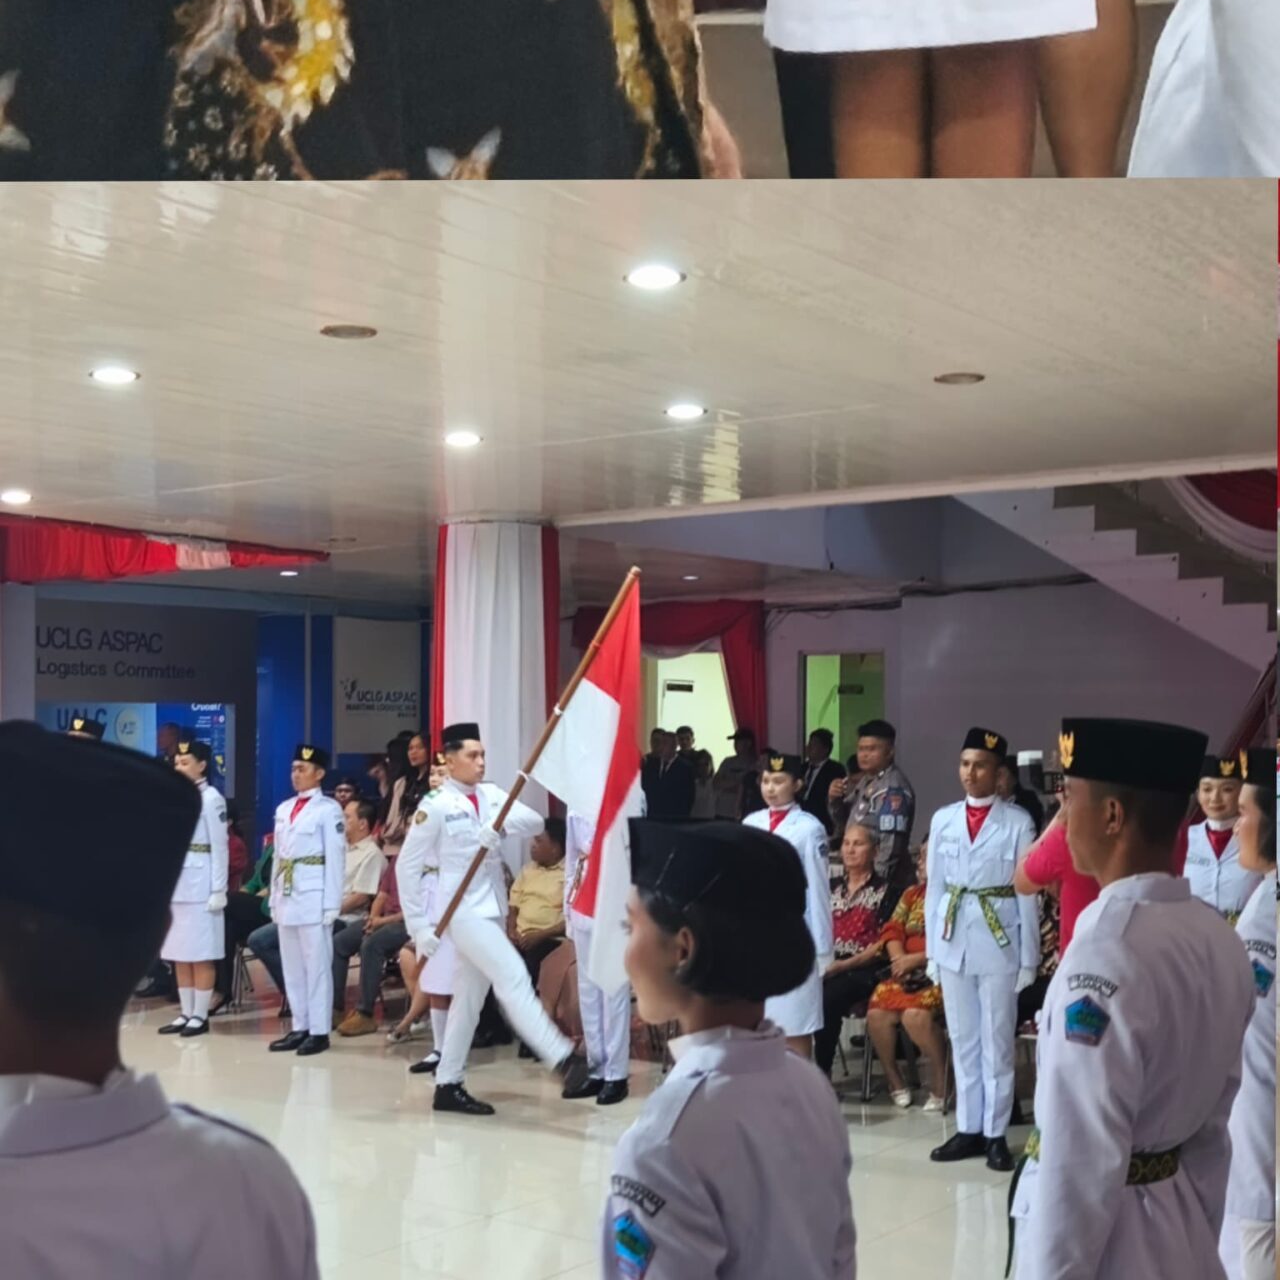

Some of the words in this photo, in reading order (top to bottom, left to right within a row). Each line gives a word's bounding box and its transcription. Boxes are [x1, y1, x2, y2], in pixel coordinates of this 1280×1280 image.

[35, 625, 93, 651] UCLG
[98, 629, 163, 654] ASPAC
[36, 658, 107, 679] Logistics
[114, 661, 196, 679] Committee
